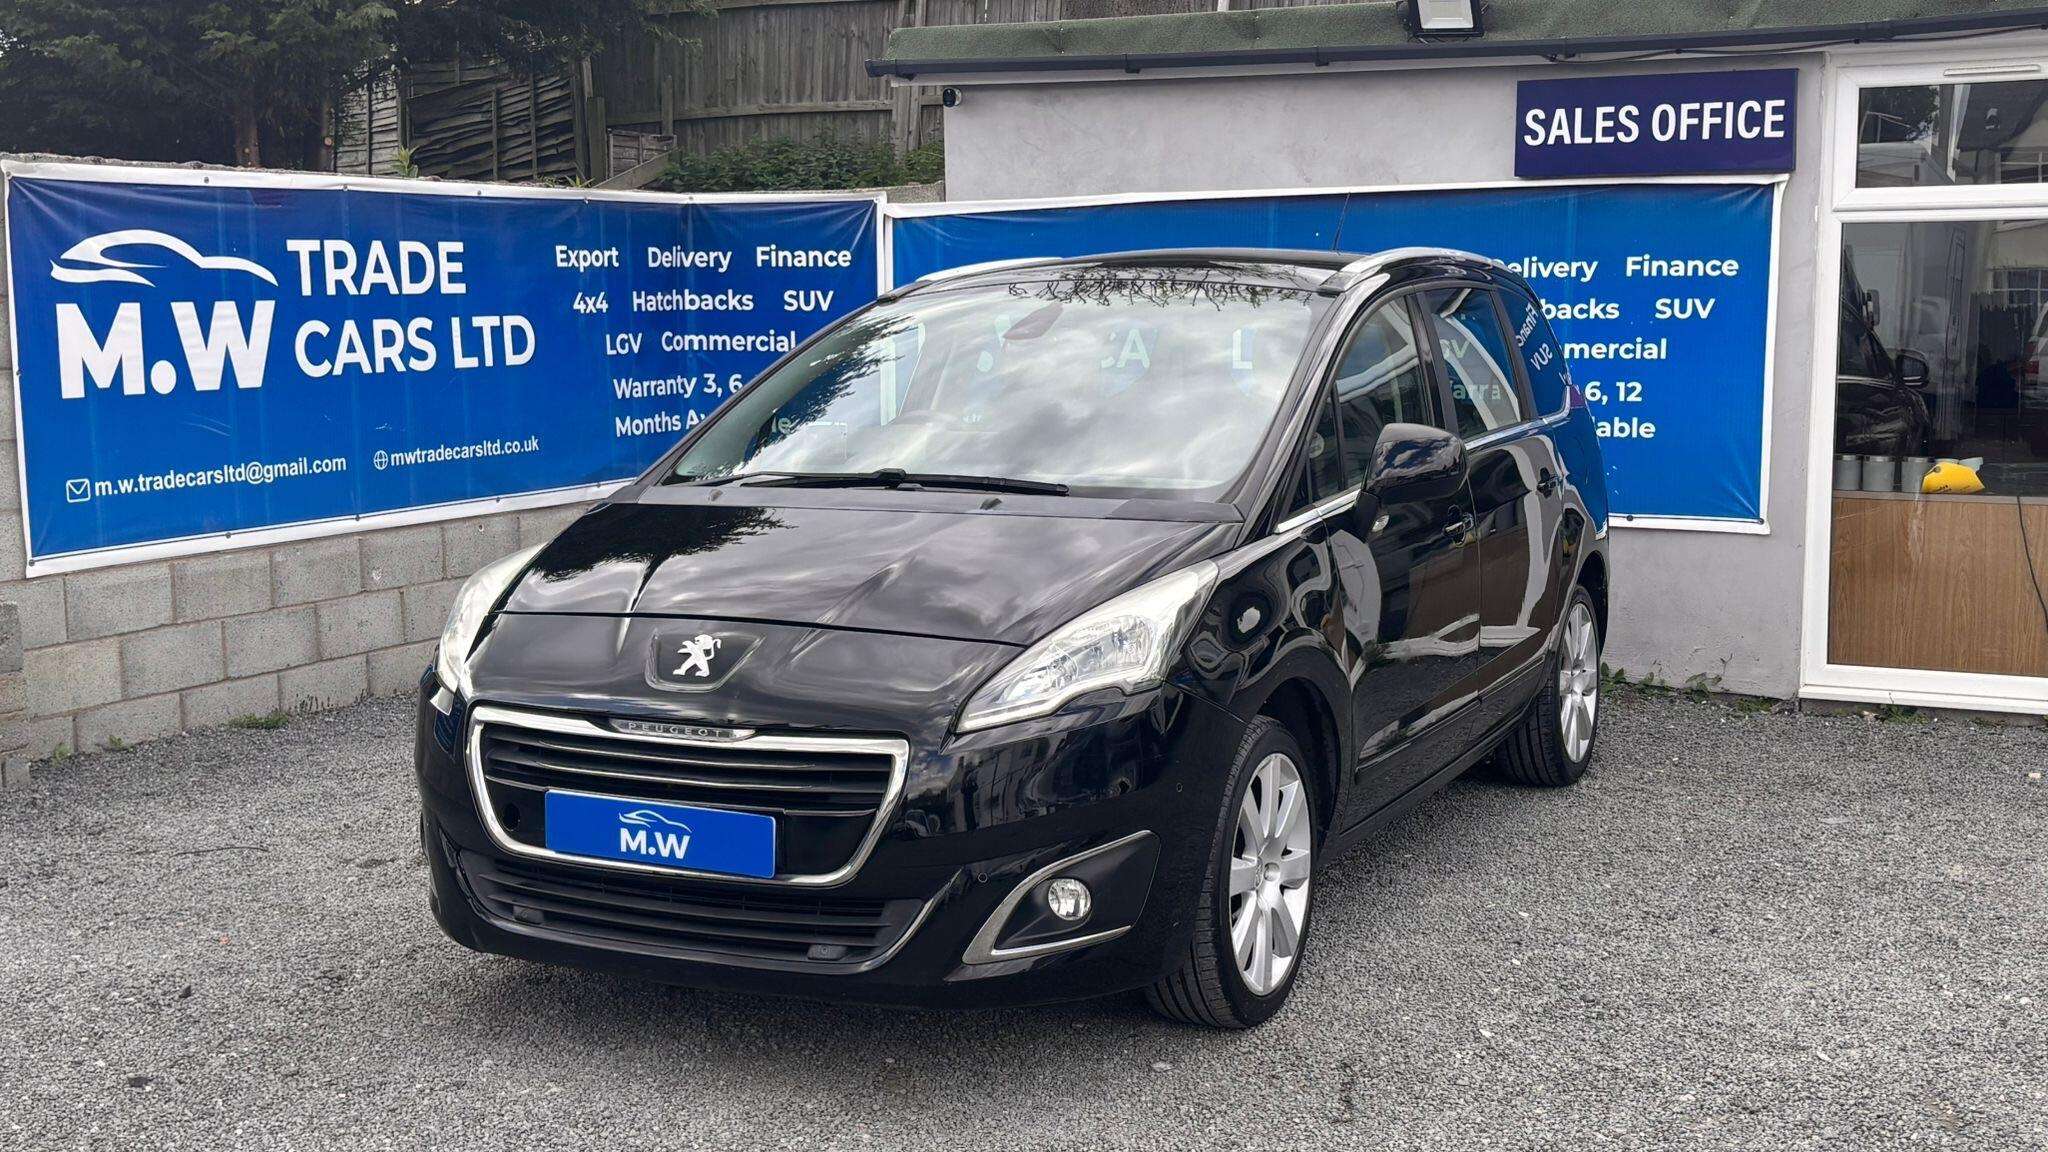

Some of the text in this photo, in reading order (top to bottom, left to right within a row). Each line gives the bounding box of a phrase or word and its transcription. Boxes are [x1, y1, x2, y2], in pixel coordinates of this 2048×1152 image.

[1523, 99, 1786, 146] SALES OFFICE
[286, 239, 467, 296] TRADE
[555, 245, 852, 273] Export Delivery Finance
[1626, 254, 1739, 277] Finance
[573, 288, 834, 314] 4x4 Hatchbacks SUV
[1655, 298, 1716, 320] SUV
[55, 299, 276, 399] M.W
[294, 315, 536, 378] CARS LTD
[605, 329, 797, 355] LGV Commercial
[1563, 337, 1667, 360] mercial
[613, 375, 697, 399] Warranty
[703, 373, 723, 398] 3,
[1584, 381, 1643, 406] 6, 12
[615, 410, 682, 437] Months
[390, 435, 539, 467] mwtradecarsltd.co.uk
[94, 455, 347, 499] m.w.tradecarsltd@gmail.com
[628, 721, 722, 738] PEUGEOT
[619, 827, 690, 860] M.W
